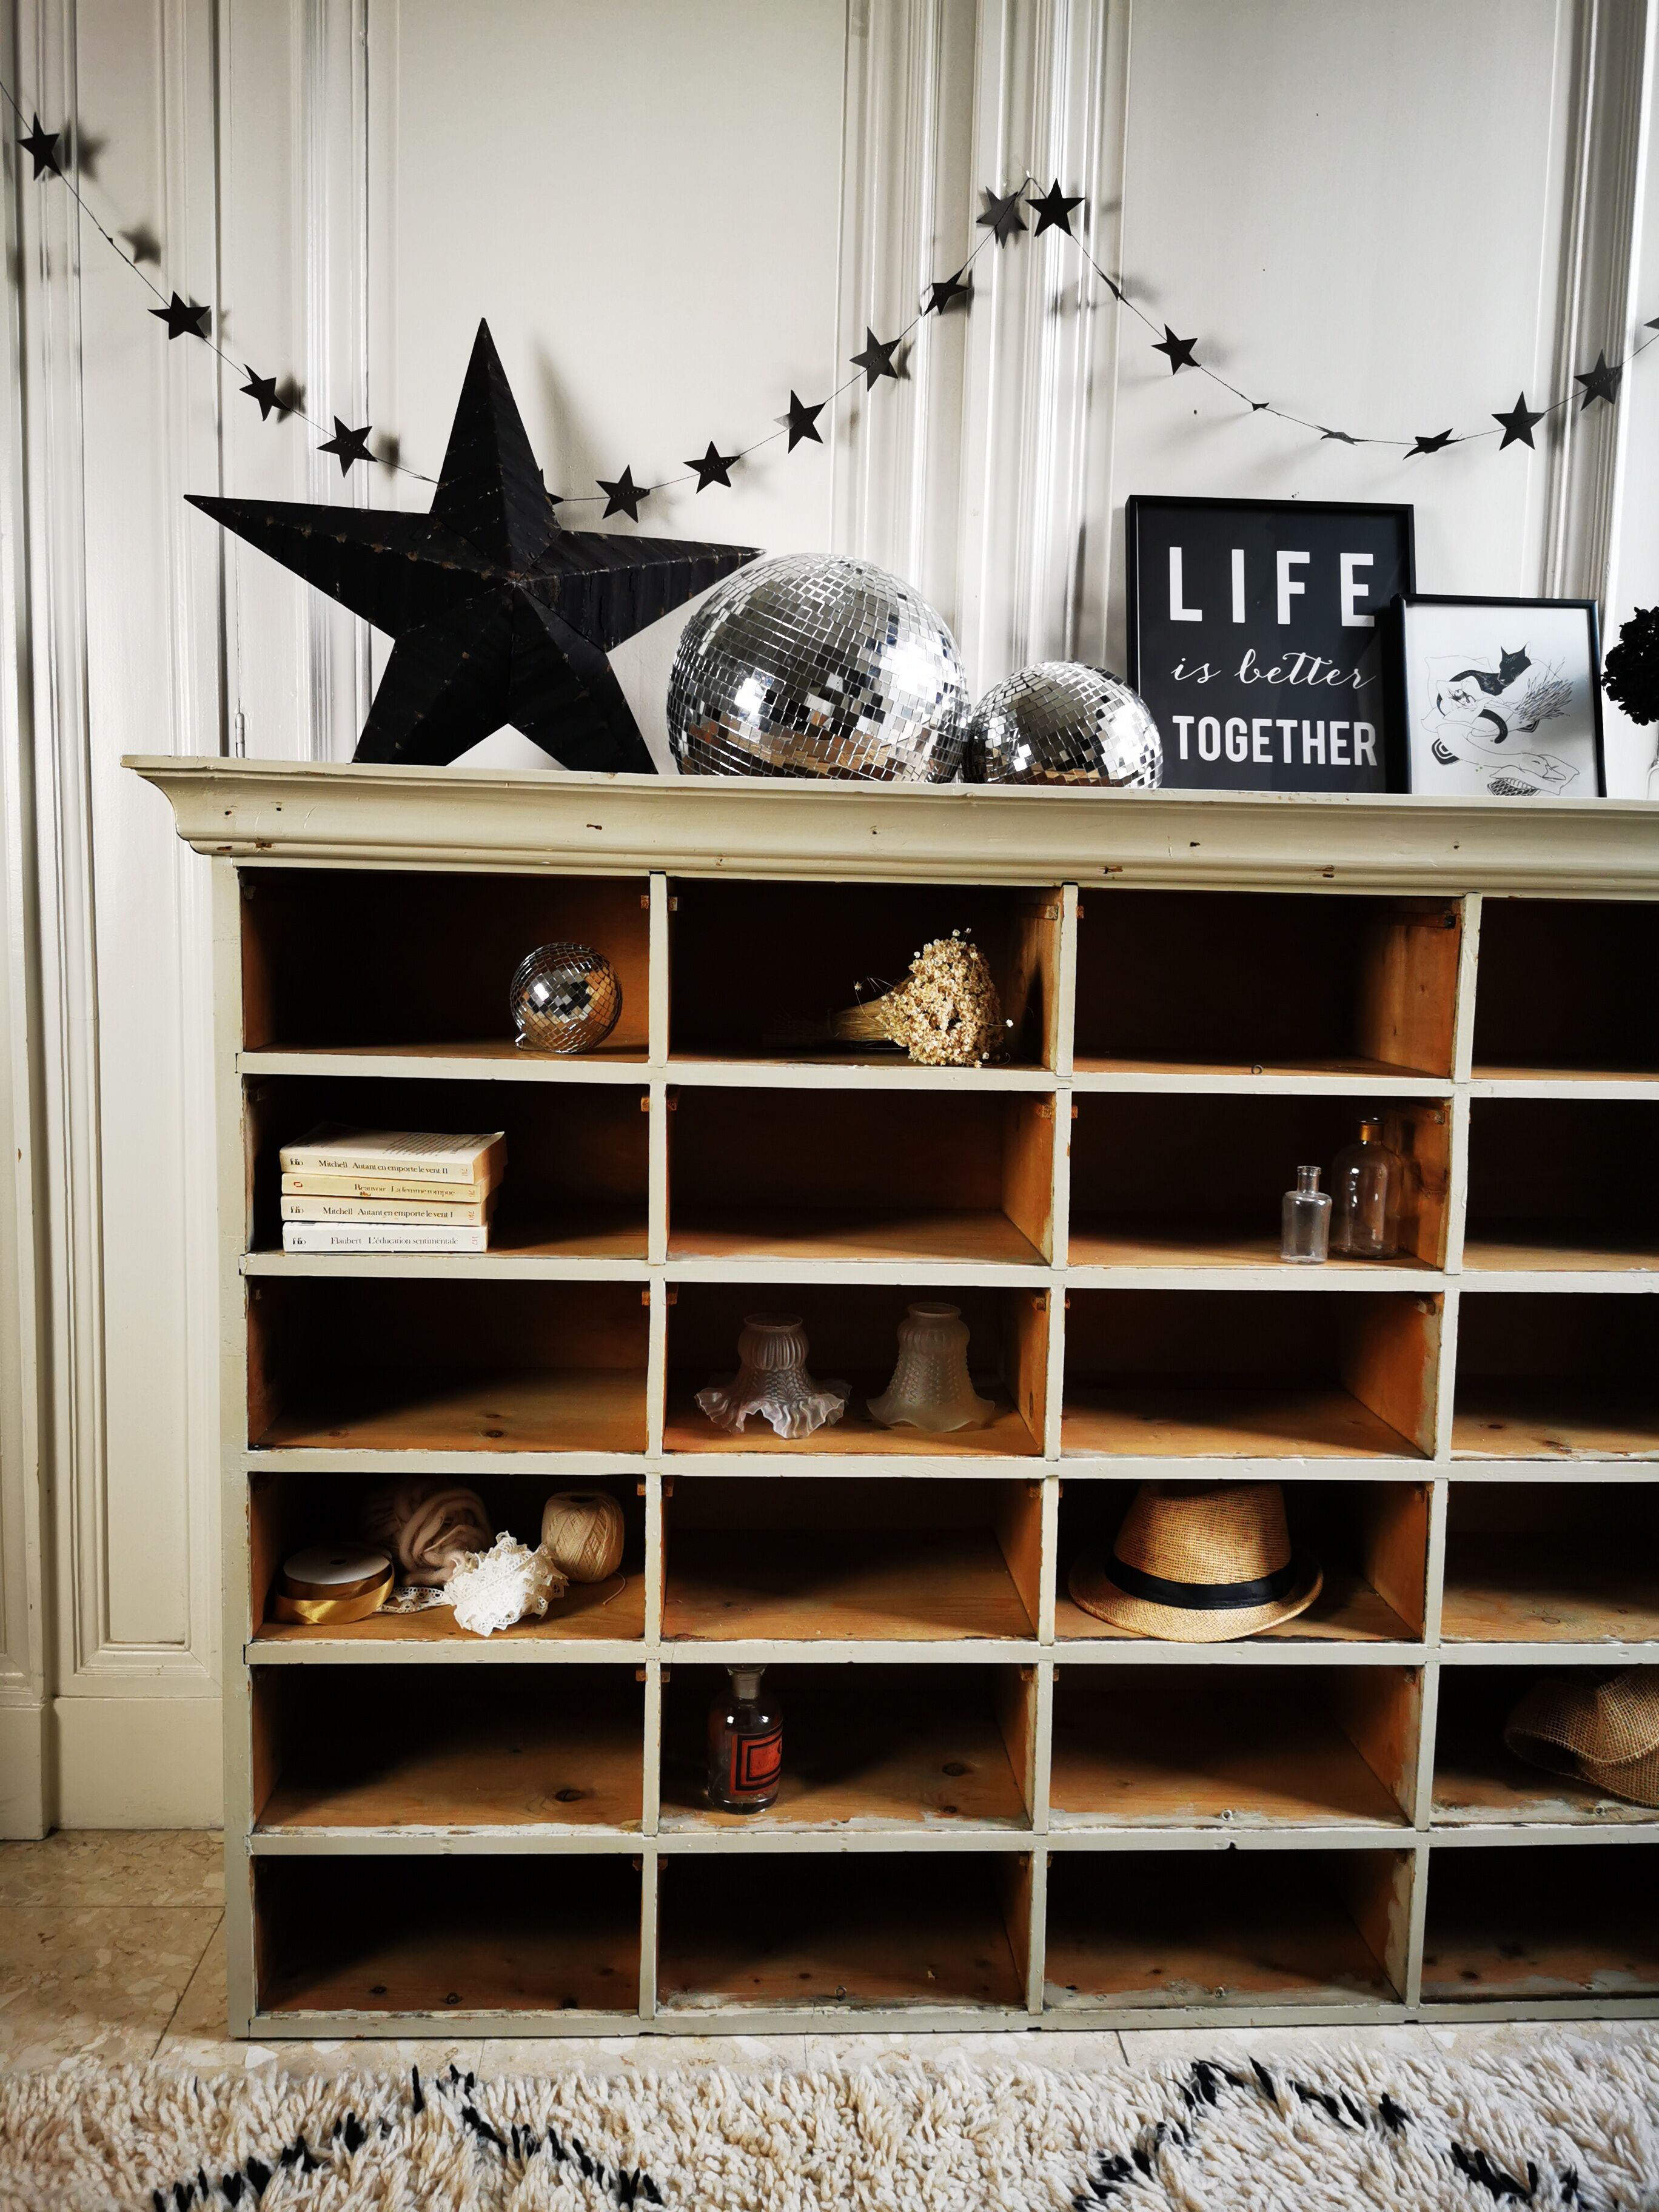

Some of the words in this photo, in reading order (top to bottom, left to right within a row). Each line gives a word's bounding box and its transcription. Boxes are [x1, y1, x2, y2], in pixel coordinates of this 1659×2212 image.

[1170, 547, 1375, 627] LIFE
[1171, 657, 1222, 684] is
[1234, 649, 1376, 689] better
[1173, 716, 1378, 767] TOGETHER
[318, 1159, 347, 1168] Mitchell
[323, 1207, 352, 1215] Mitchell
